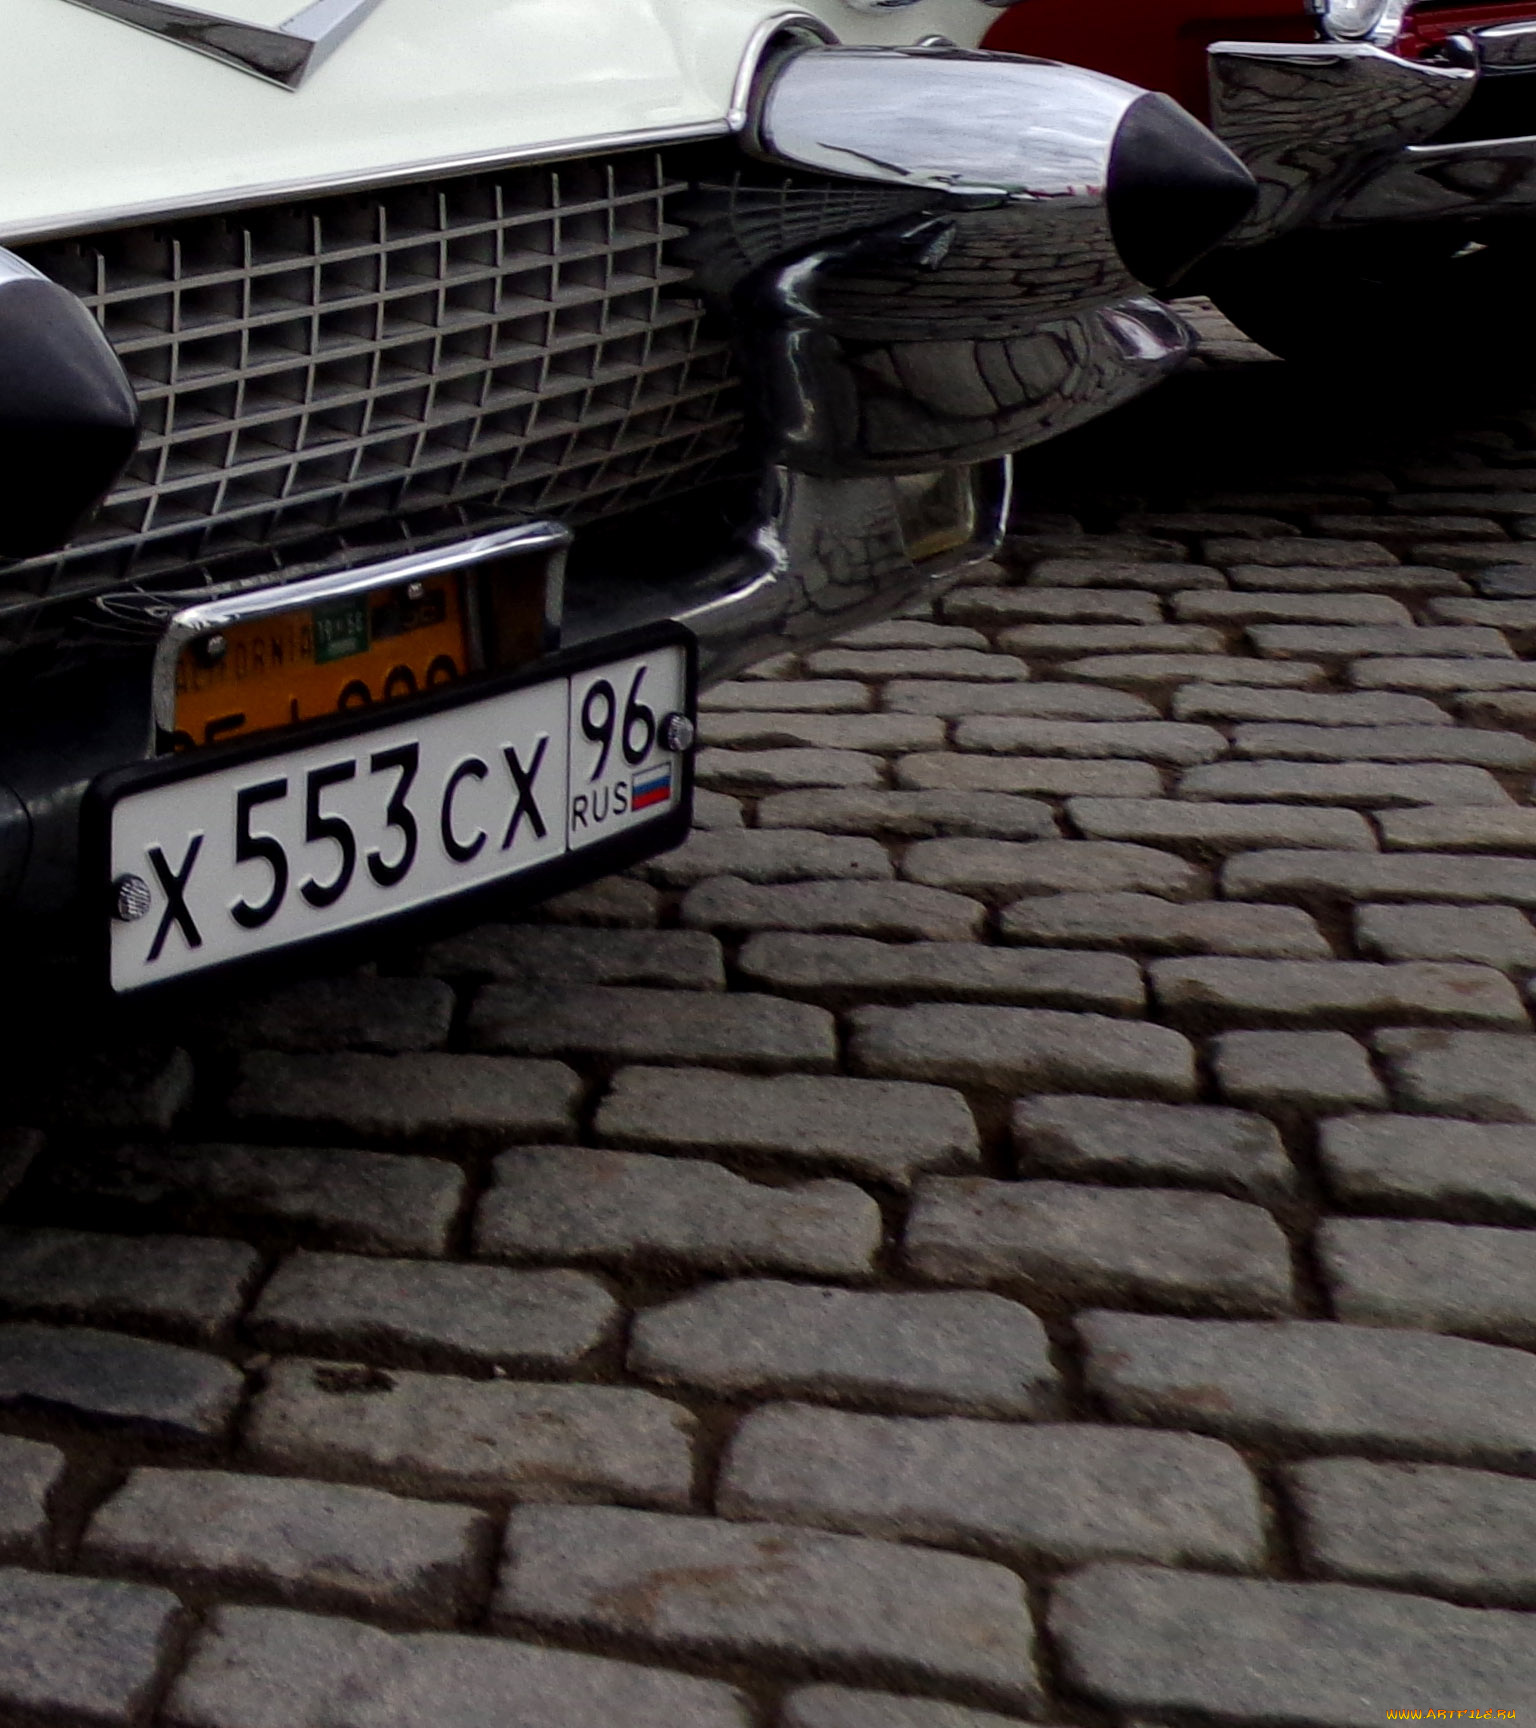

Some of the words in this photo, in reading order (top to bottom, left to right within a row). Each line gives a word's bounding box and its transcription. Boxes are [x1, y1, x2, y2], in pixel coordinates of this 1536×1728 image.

[175, 624, 311, 697] ALIFORNIA
[581, 665, 656, 782] 96
[572, 781, 630, 832] RUS
